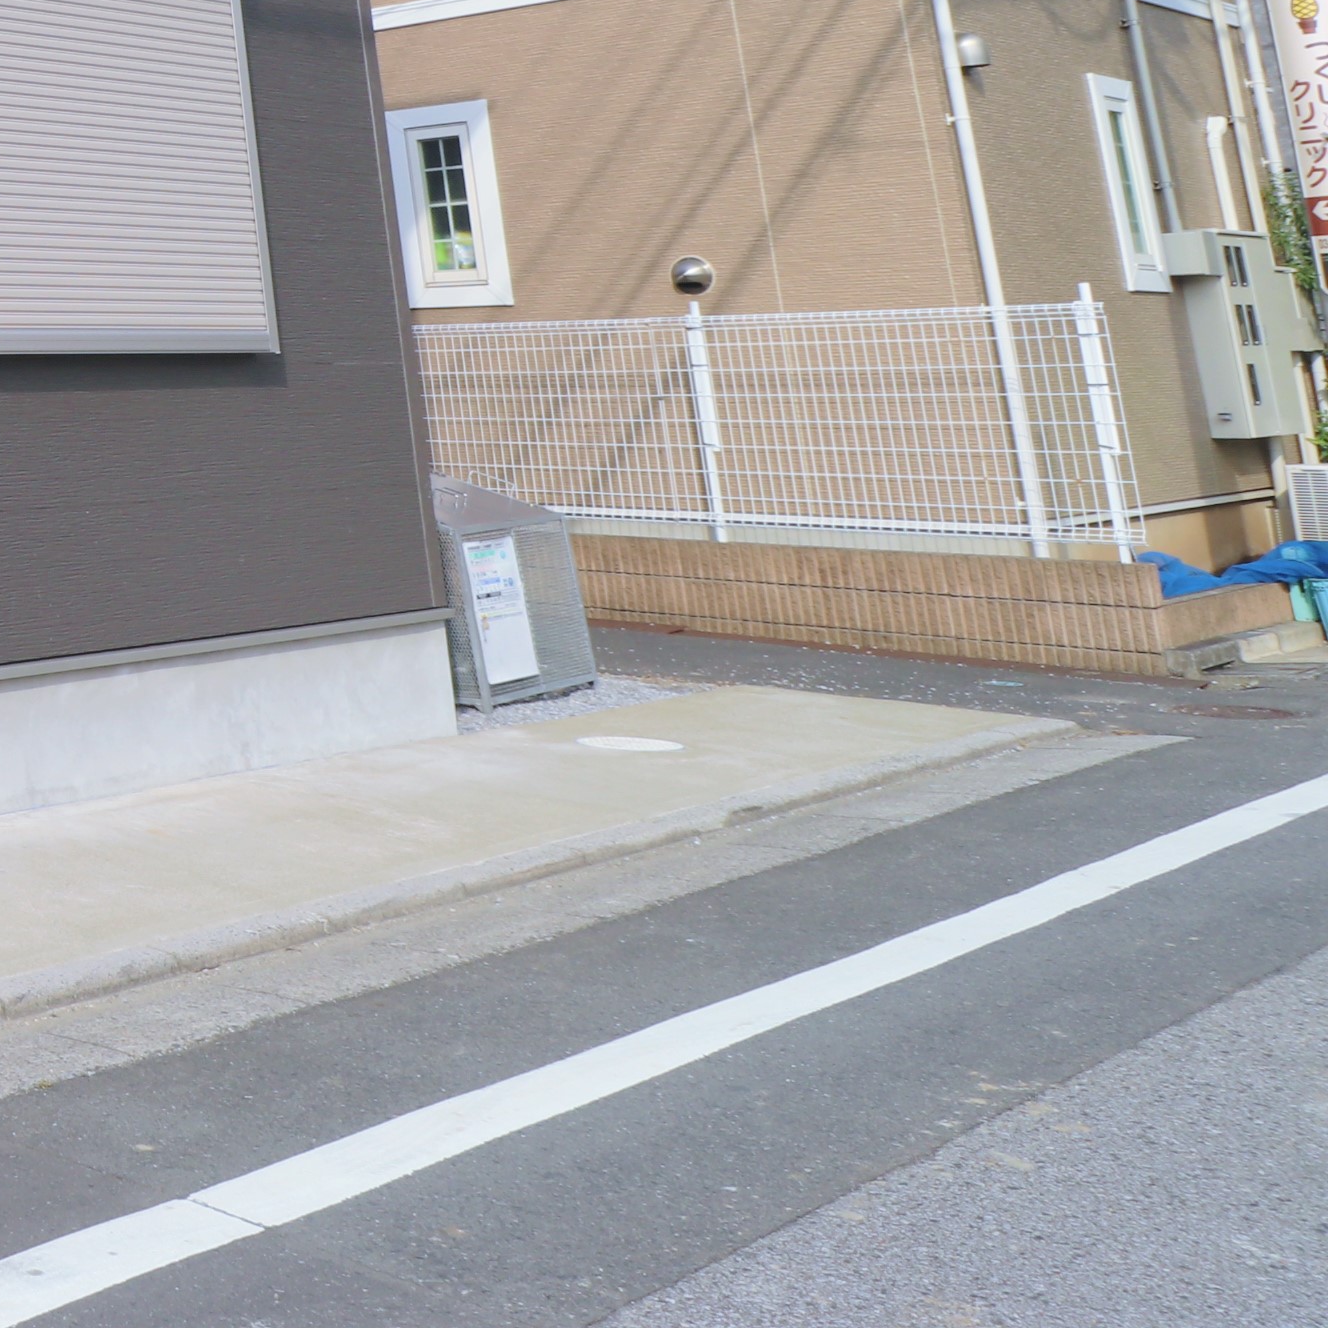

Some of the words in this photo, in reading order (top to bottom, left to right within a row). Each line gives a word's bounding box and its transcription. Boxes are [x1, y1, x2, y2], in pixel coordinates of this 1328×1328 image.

[1290, 79, 1327, 188] クリニック
